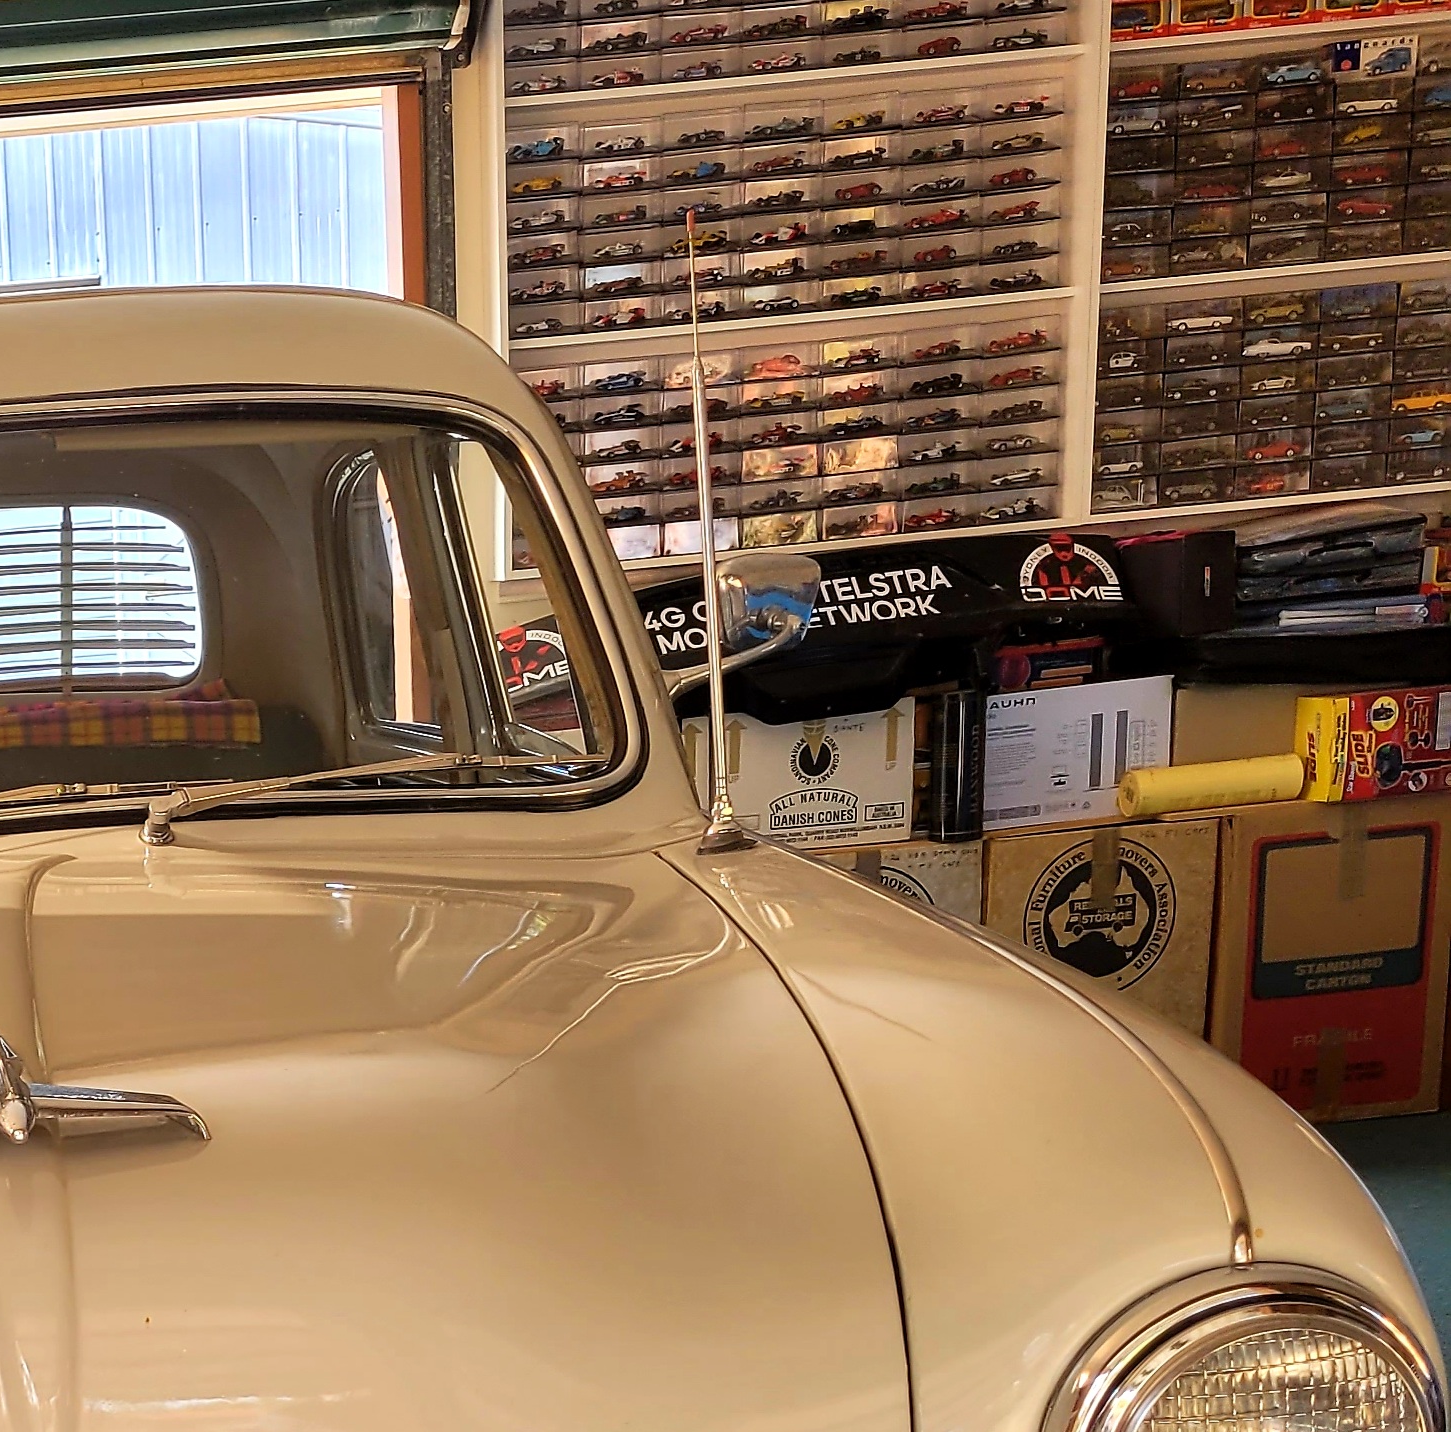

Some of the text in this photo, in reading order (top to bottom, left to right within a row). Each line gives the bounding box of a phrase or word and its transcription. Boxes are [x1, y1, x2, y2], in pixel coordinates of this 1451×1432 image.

[1078, 547, 1114, 580] INDOOR
[643, 608, 686, 631] 4G
[820, 565, 953, 603] TELSTRA
[1020, 585, 1124, 602] DOME
[808, 594, 942, 629] ETWORK
[989, 697, 1037, 710] AUHN
[817, 735, 840, 785] CONE COMPANY
[1351, 733, 1370, 776] SLIDE
[774, 791, 852, 813] ALL NATURAL
[773, 808, 854, 827] DANISH CONES
[1029, 851, 1086, 913] Furniture
[1132, 882, 1170, 971] Association
[1081, 911, 1134, 924] STORAGE
[1294, 956, 1384, 976] STANDARD
